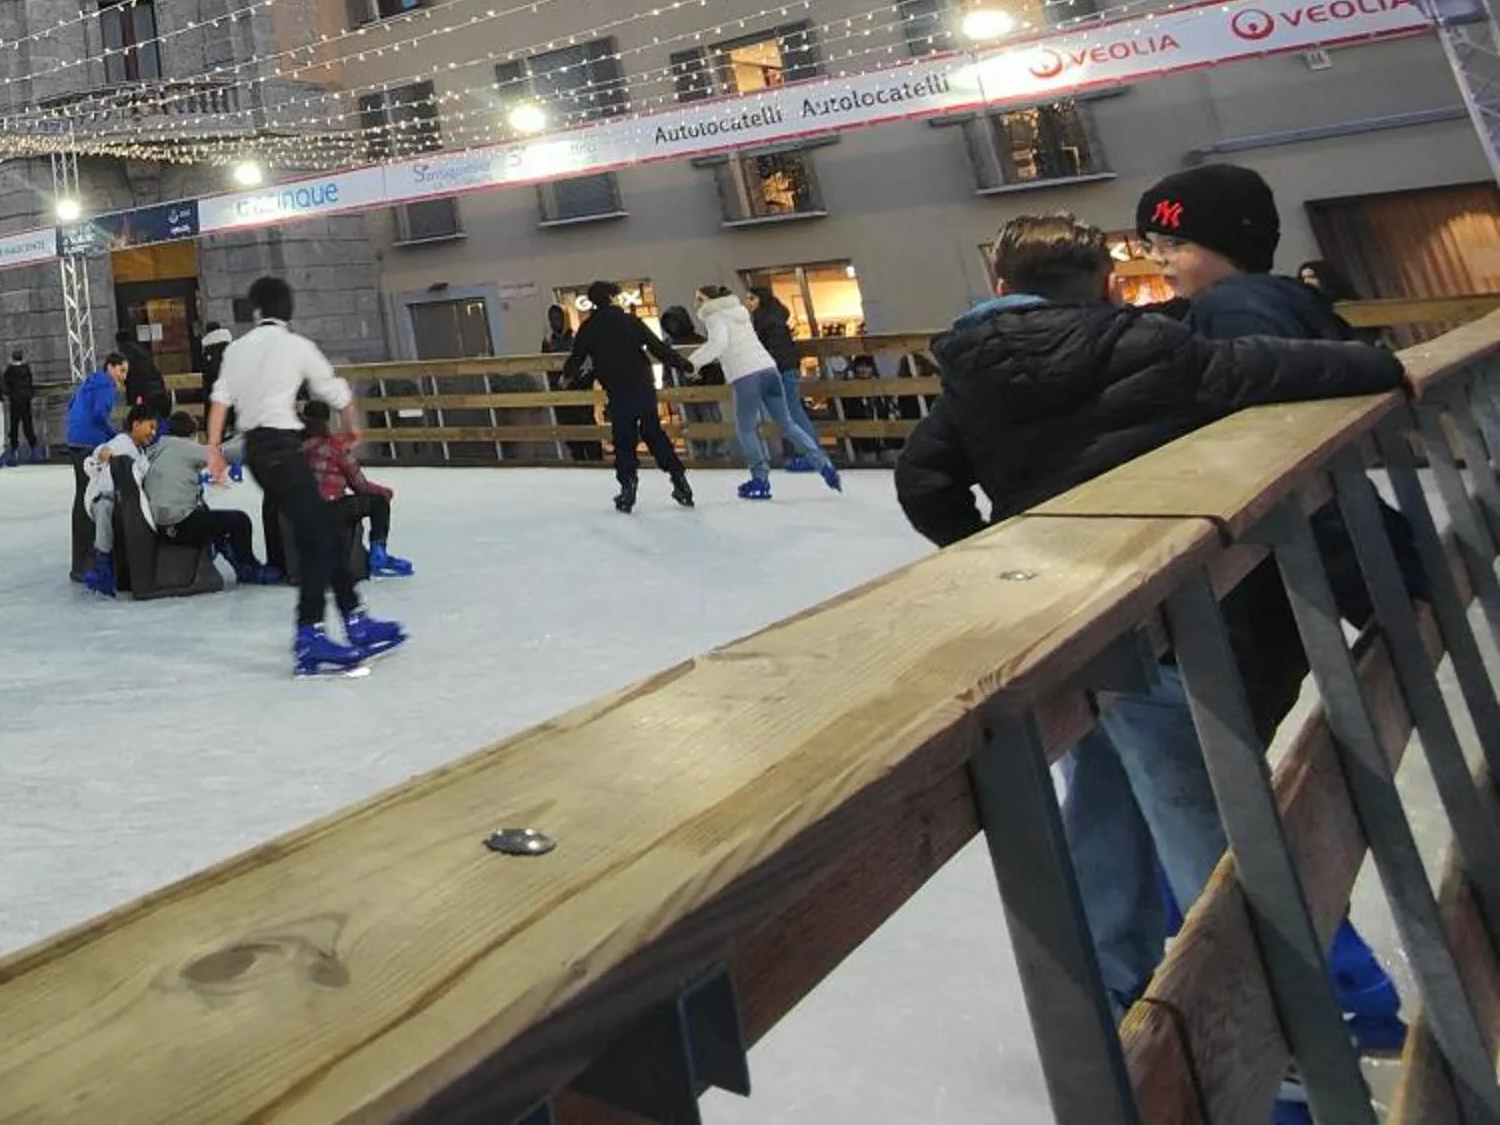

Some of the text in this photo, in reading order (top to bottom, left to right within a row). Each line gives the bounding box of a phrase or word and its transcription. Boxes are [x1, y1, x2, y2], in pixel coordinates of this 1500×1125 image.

[1070, 34, 1180, 67] VEOLIA
[654, 74, 951, 145] Autolocatelli Autolocatelli
